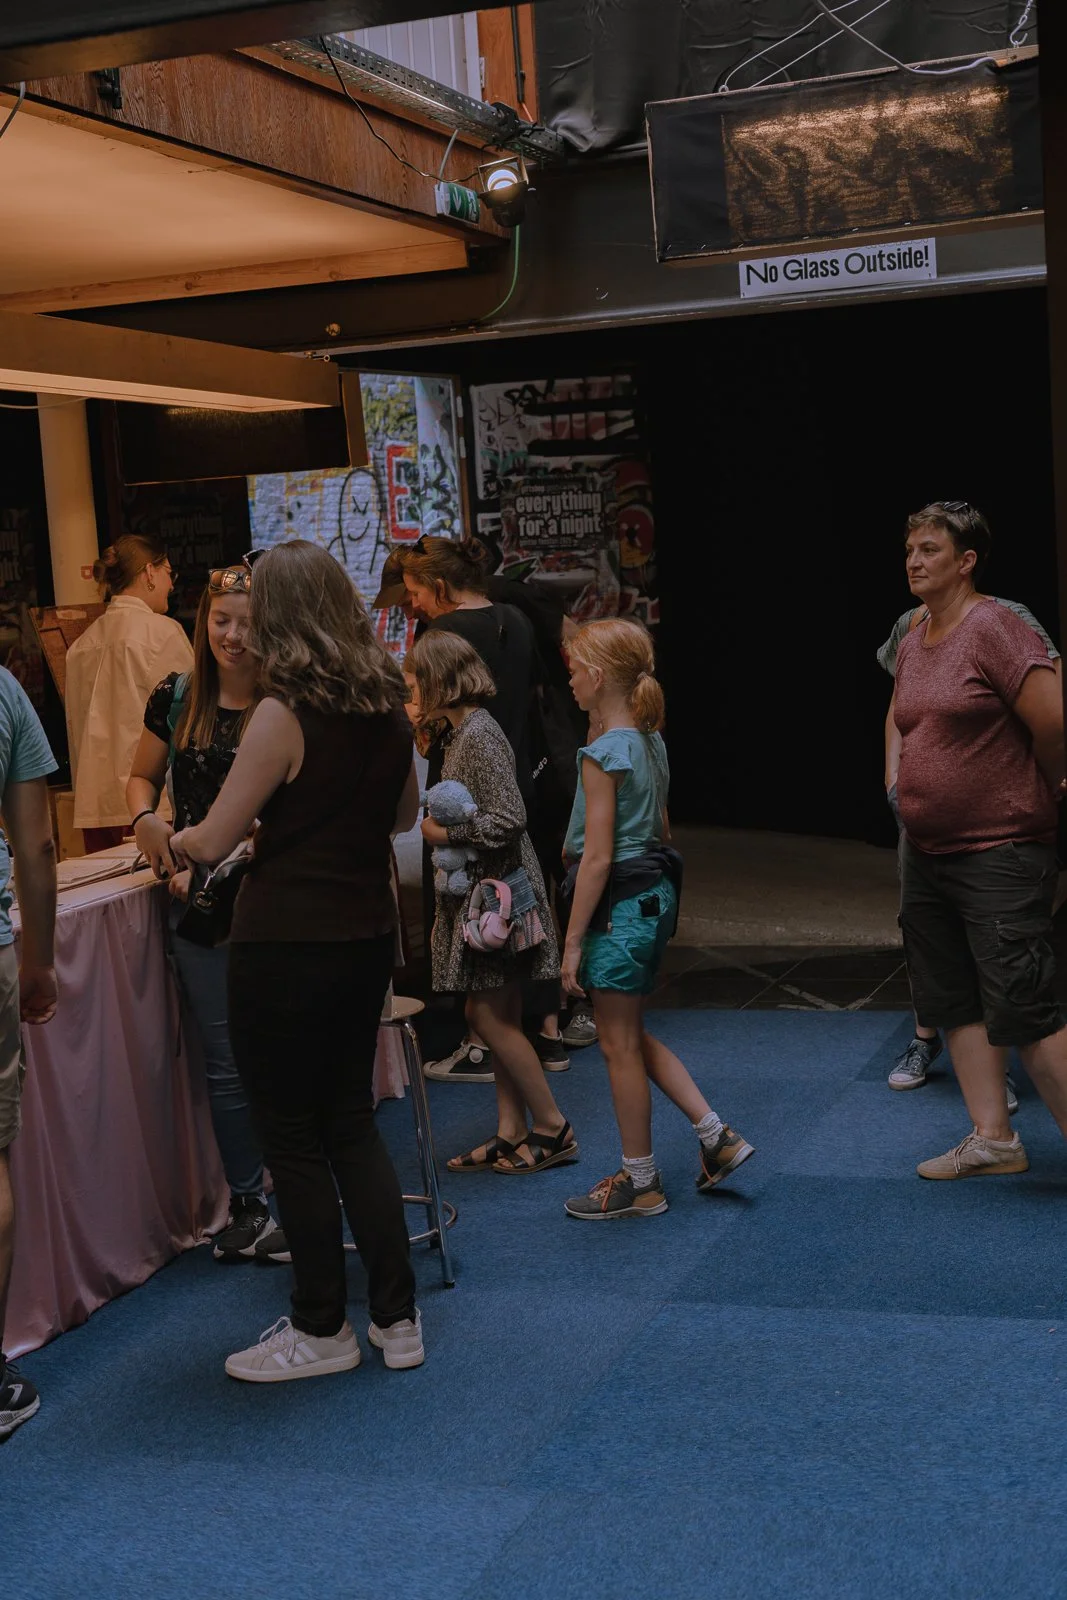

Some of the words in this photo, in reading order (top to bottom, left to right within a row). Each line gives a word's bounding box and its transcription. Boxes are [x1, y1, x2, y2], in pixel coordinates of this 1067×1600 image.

[745, 262, 778, 286] No
[782, 257, 840, 281] Glass
[844, 245, 930, 275] Outside!
[515, 489, 602, 516] everything
[518, 515, 545, 537] for
[547, 518, 558, 536] a
[560, 513, 602, 538] night
